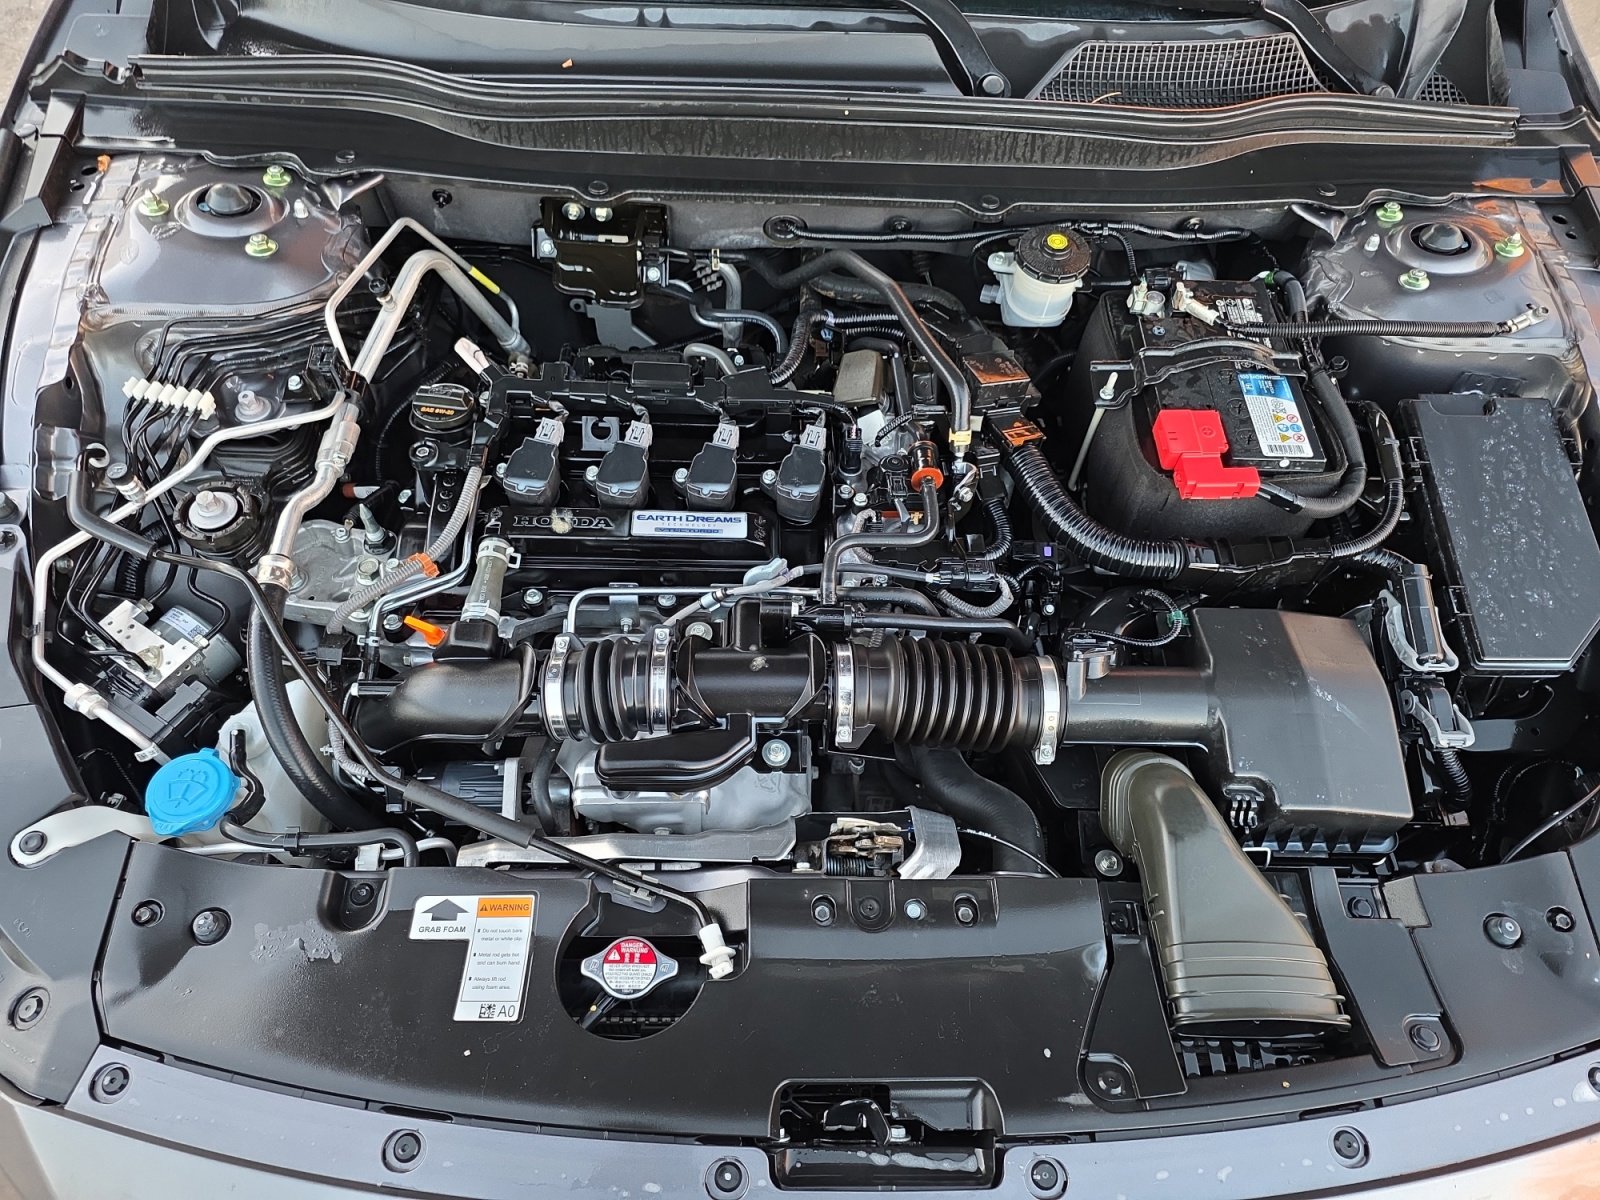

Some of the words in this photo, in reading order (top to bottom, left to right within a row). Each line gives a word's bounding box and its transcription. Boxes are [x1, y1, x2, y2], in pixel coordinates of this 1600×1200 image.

[512, 514, 615, 530] HODA
[636, 514, 683, 522] EARTH
[686, 514, 742, 523] DREAMS
[490, 903, 530, 912] WARNING
[497, 1004, 516, 1018] A0
